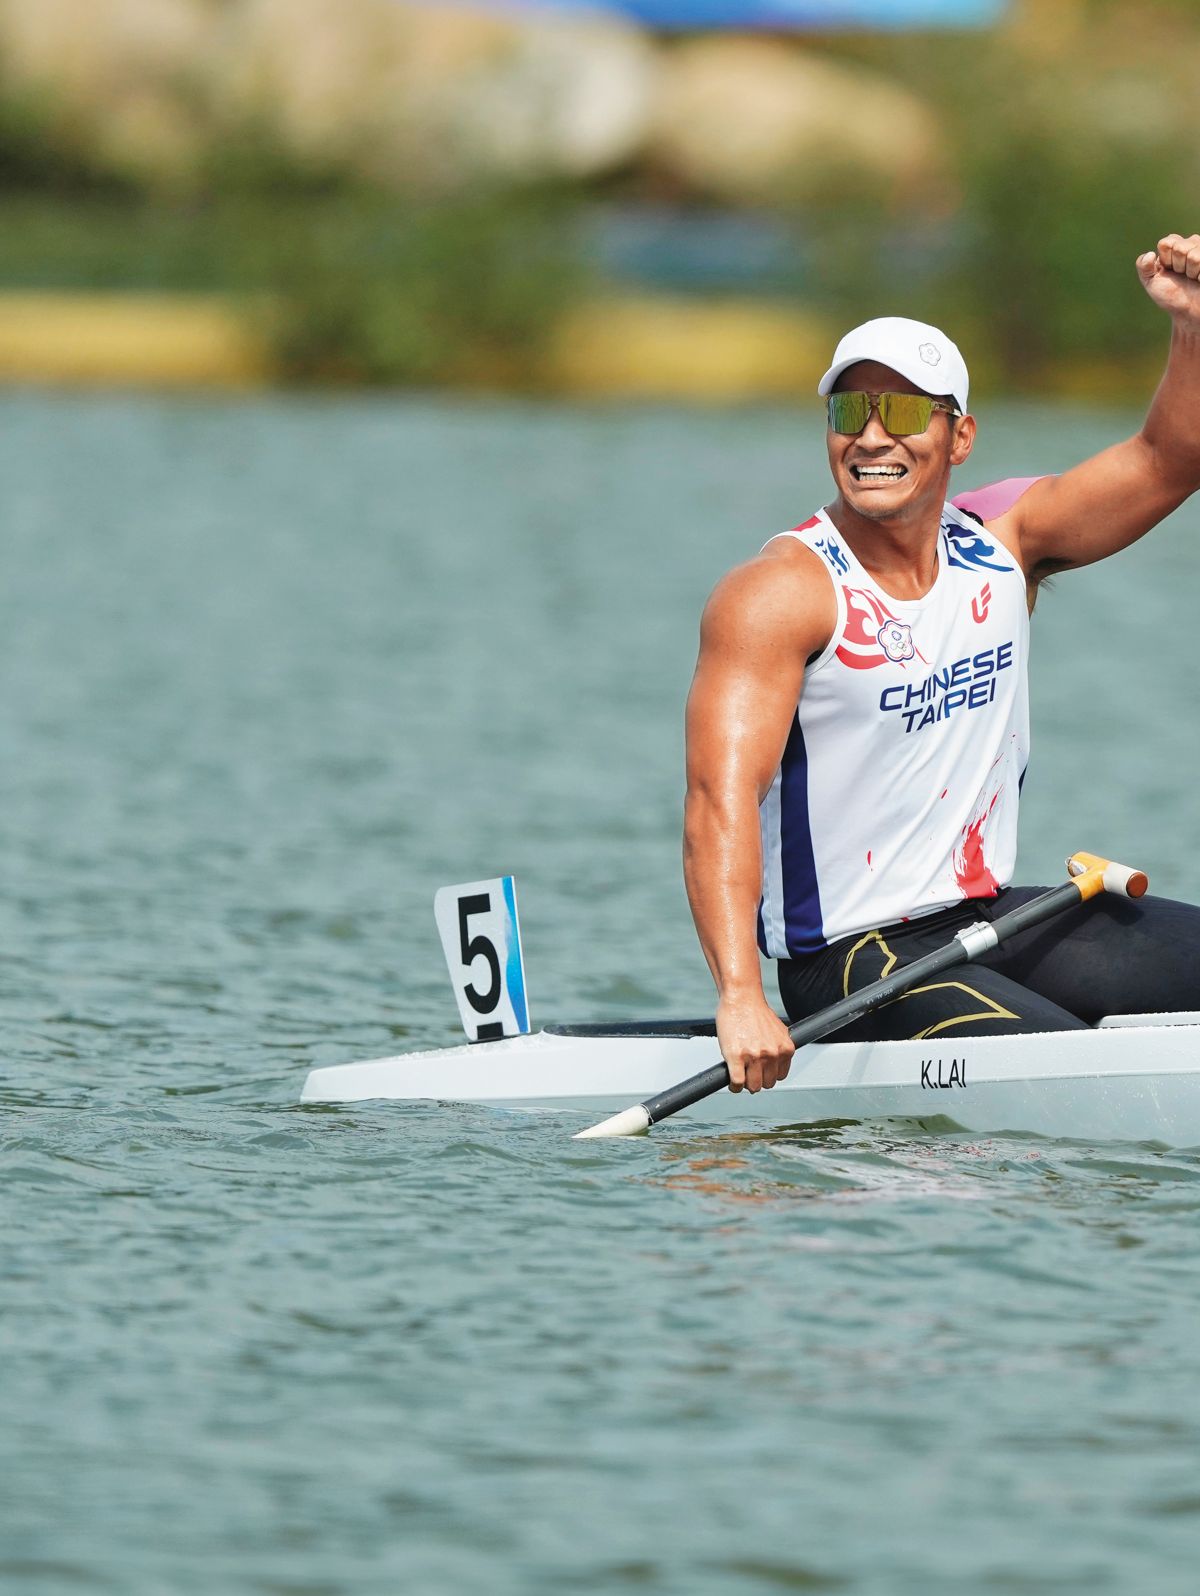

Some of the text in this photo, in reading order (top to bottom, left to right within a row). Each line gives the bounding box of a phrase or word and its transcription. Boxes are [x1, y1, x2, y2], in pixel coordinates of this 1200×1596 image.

[880, 641, 1013, 712] CHINESE
[901, 677, 997, 734] TAIPEI
[457, 893, 502, 1015] 5
[921, 1058, 967, 1089] K.LAI
